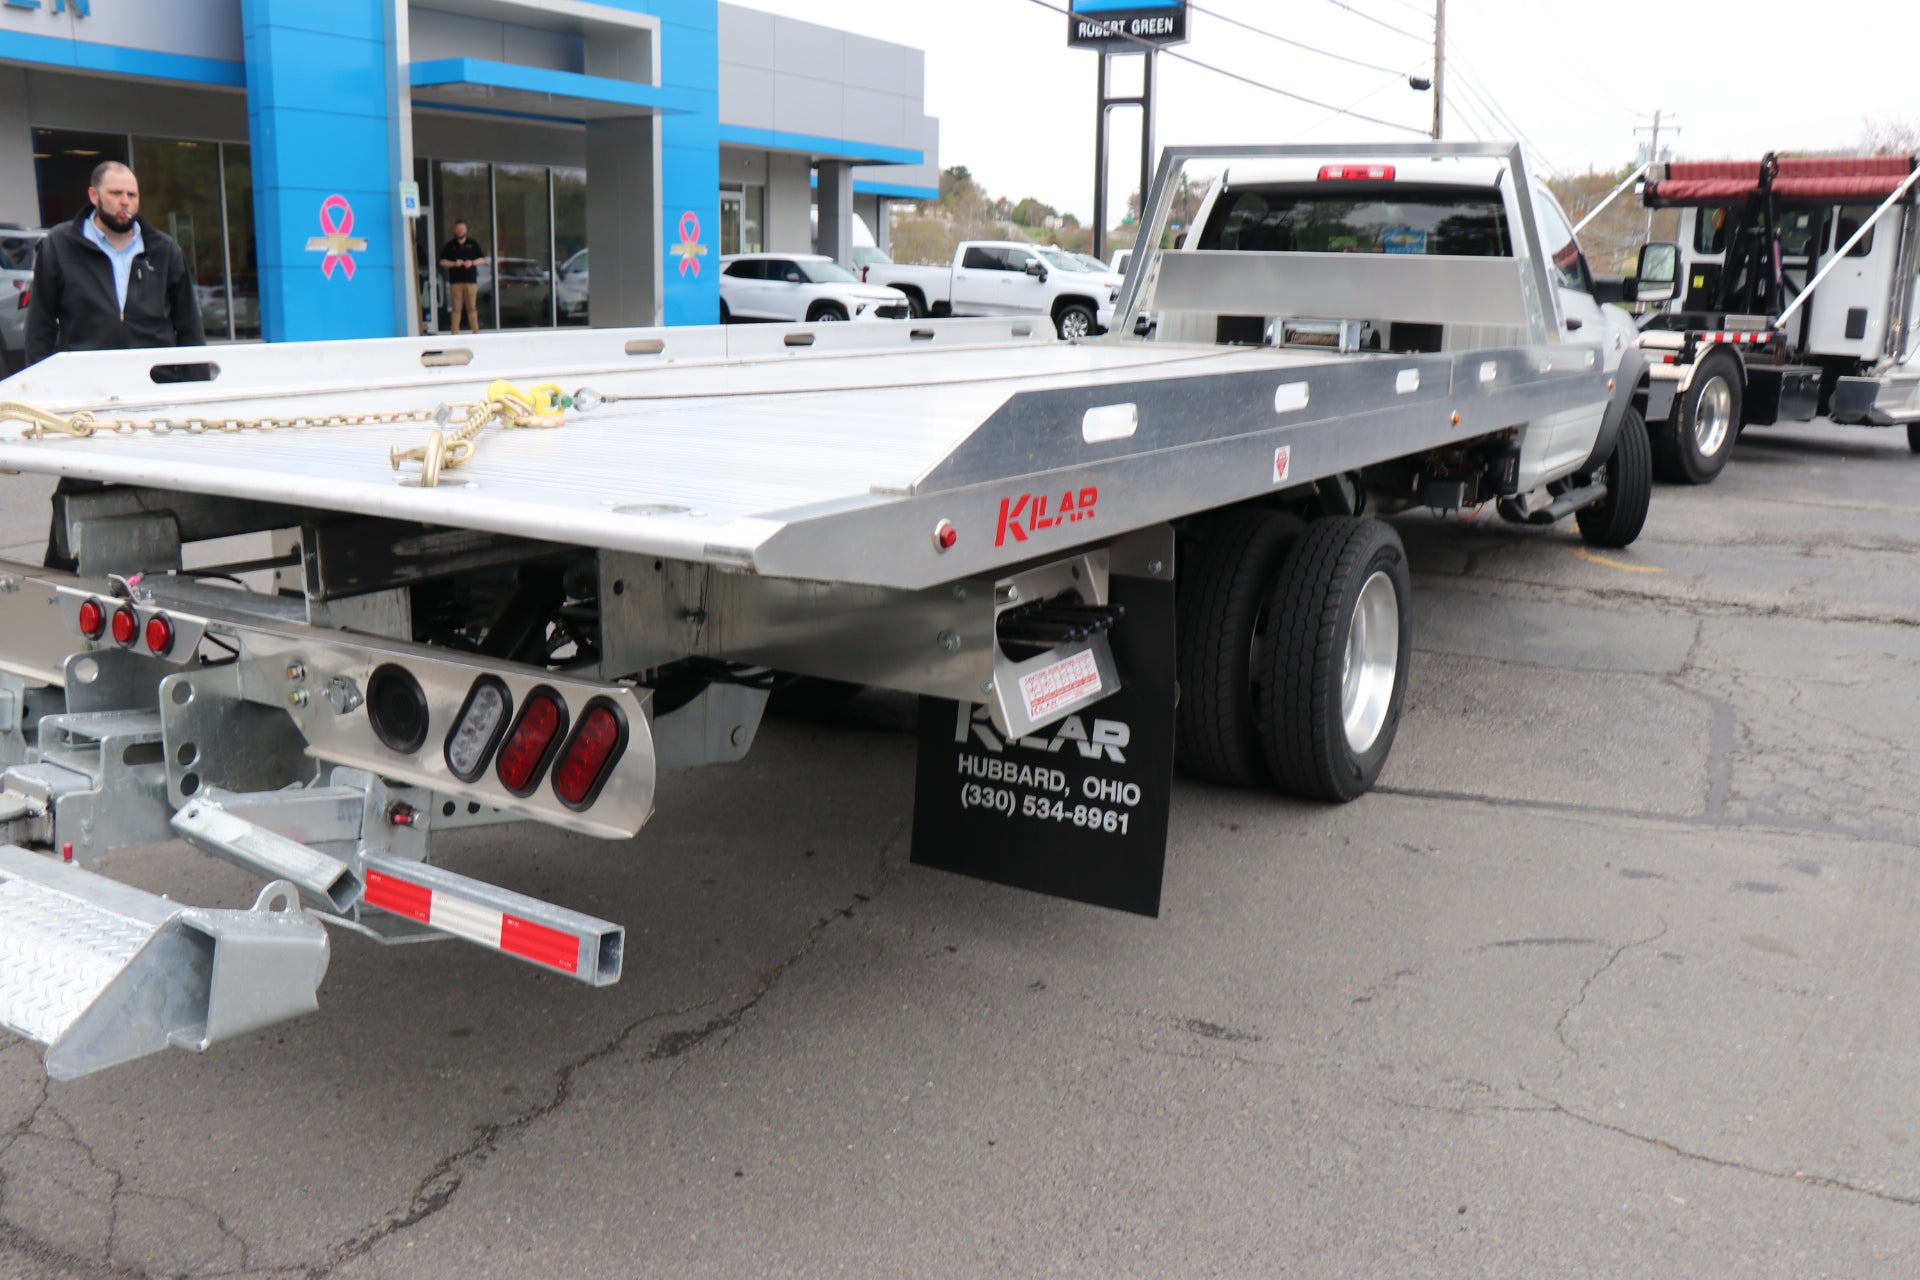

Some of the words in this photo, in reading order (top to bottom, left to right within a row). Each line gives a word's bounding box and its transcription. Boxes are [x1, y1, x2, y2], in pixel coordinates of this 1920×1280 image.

[1078, 19, 1126, 38] ROBERT
[1131, 17, 1174, 35] GREEN
[994, 485, 1099, 548] KILAR
[954, 699, 1131, 764] KLAR
[957, 752, 1070, 798] HUBBARD,
[1082, 776, 1142, 807] OHIO
[960, 782, 1017, 818] (330)
[1022, 794, 1130, 836] 534-8961
